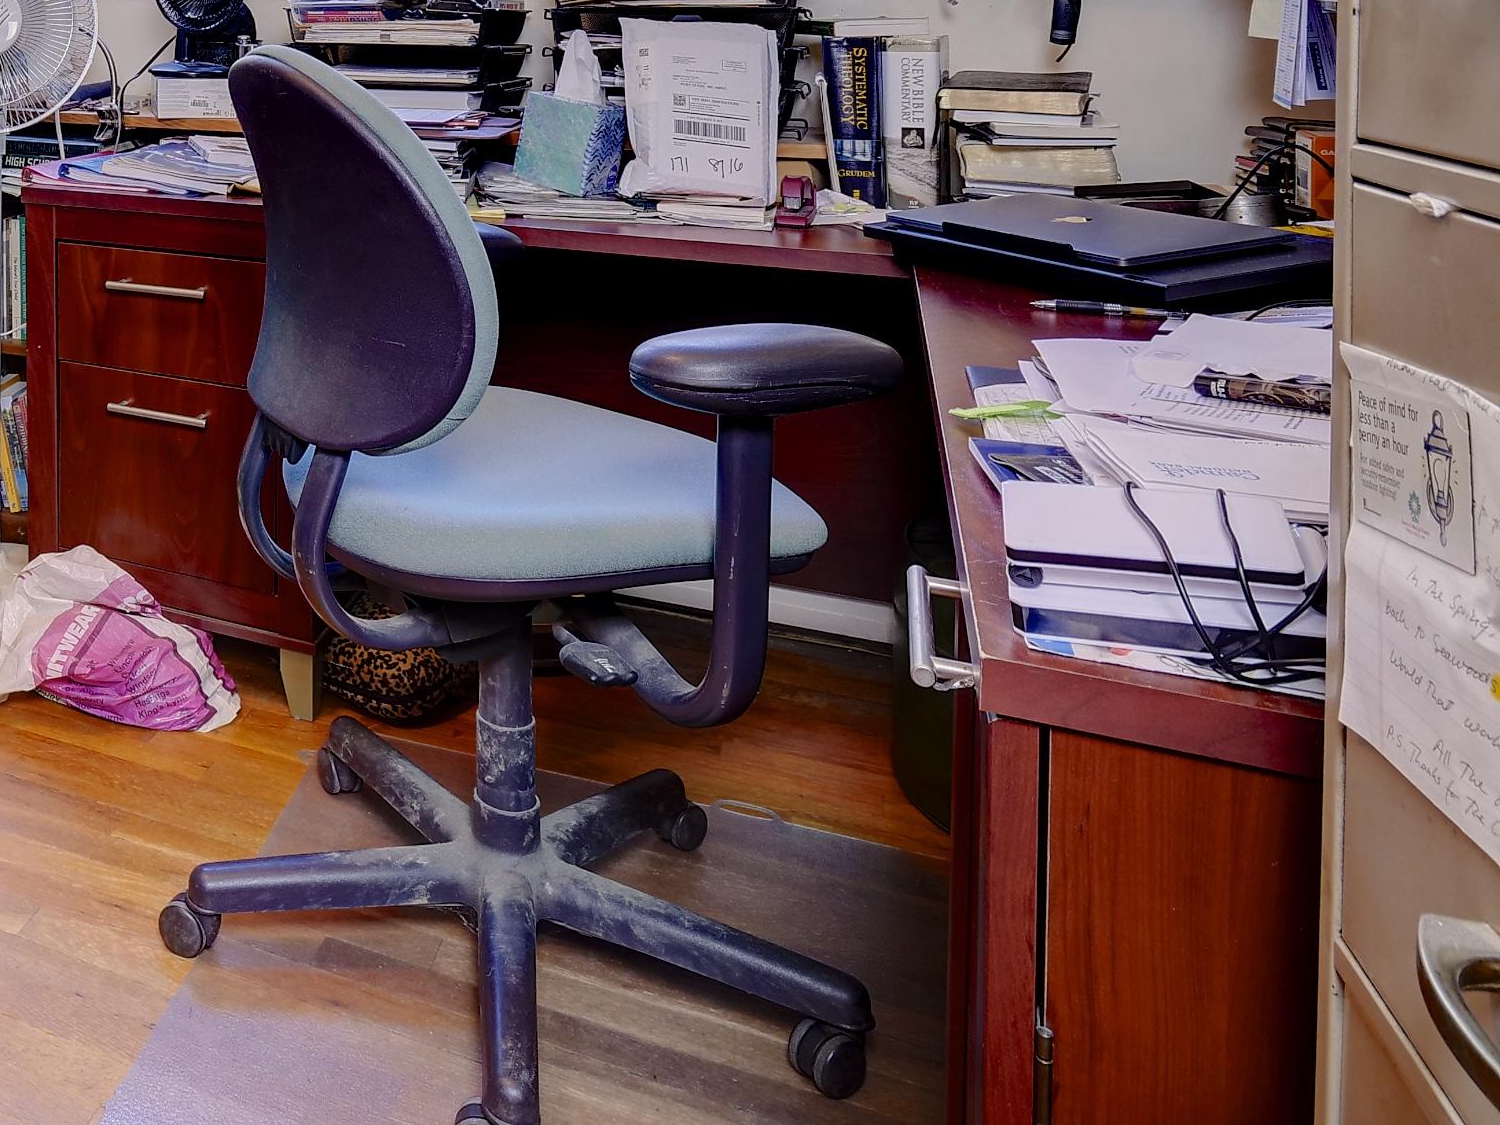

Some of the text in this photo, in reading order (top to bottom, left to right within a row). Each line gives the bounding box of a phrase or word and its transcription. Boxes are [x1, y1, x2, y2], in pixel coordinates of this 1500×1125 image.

[840, 50, 855, 126] THEOLOGY
[852, 47, 868, 131] SYSTEMATIC
[900, 57, 912, 124] COMMENTARY
[911, 57, 925, 124] NEW BIBLE
[5, 155, 26, 167] HIGH
[838, 168, 876, 178] GRUDEM
[1357, 390, 1419, 423] Peace of mind for
[1357, 409, 1396, 434] less than a
[1358, 428, 1409, 457] penny an hour
[1188, 464, 1252, 474] NATIONAL
